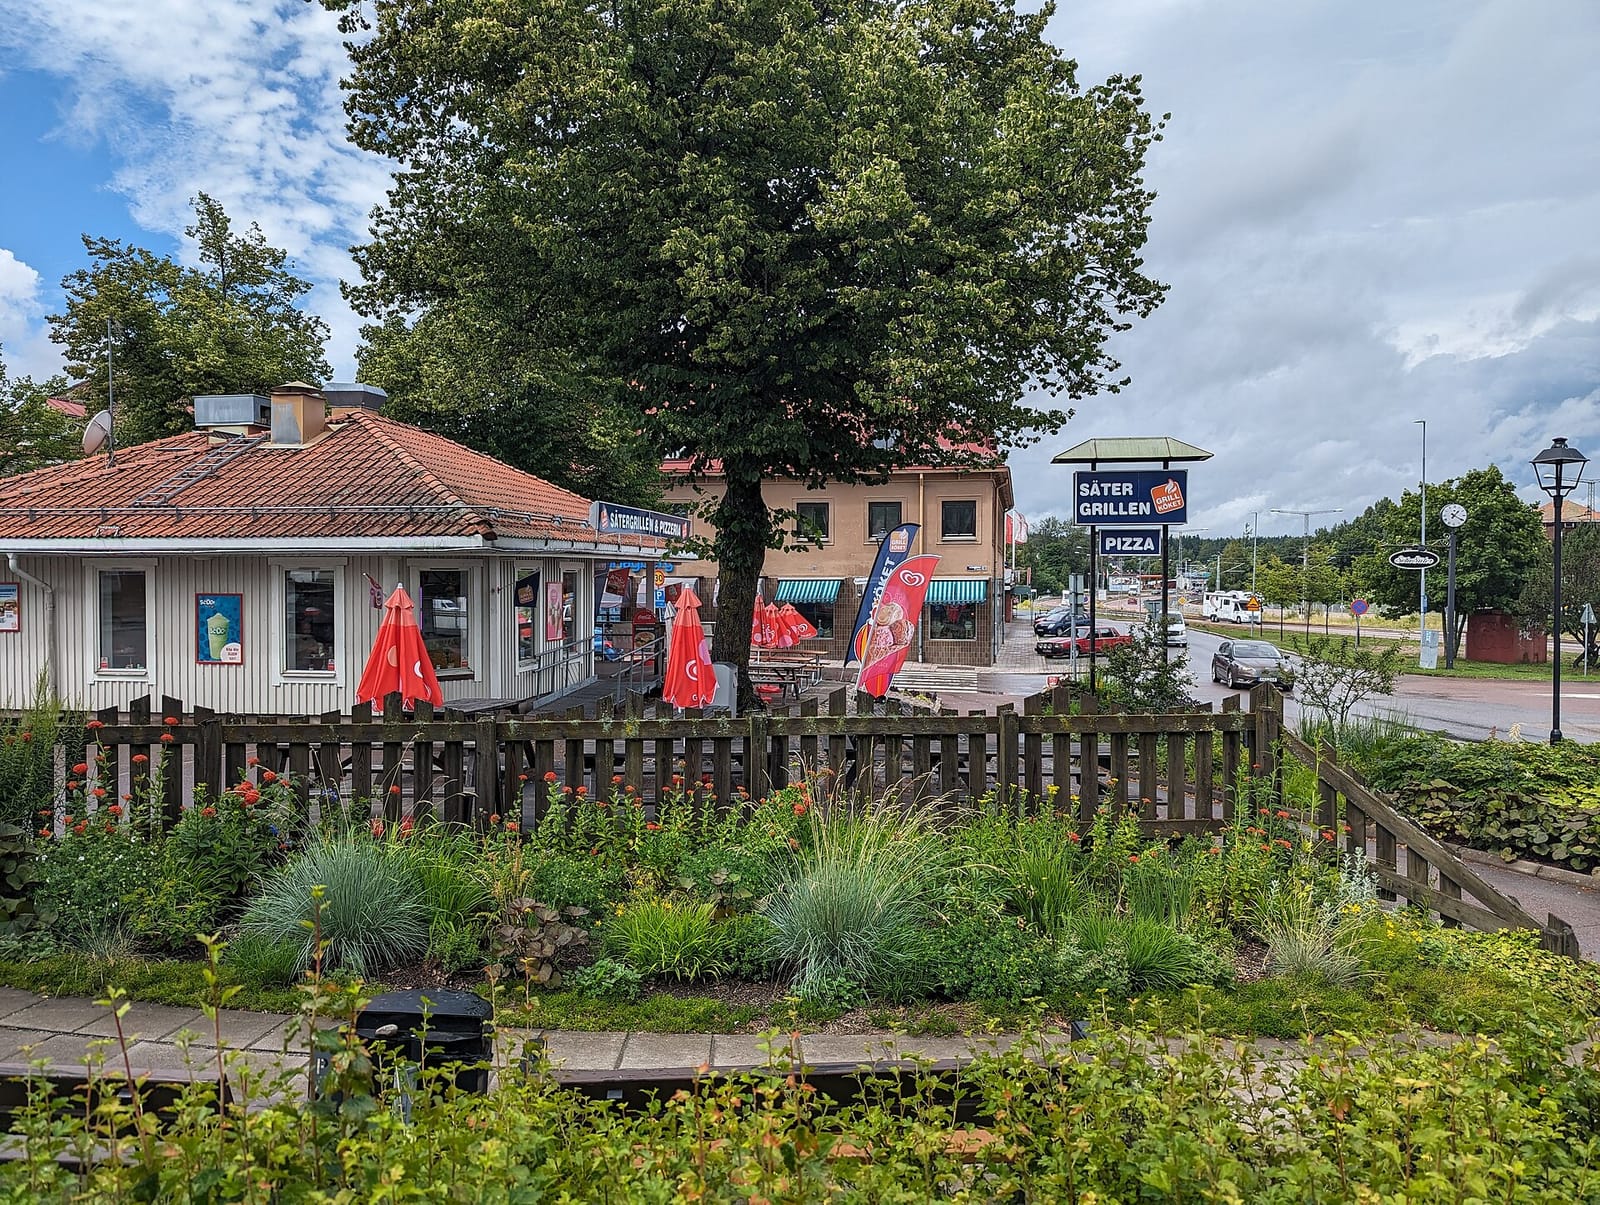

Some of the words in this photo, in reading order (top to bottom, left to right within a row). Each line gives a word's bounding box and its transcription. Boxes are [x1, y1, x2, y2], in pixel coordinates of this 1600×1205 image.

[1079, 480, 1133, 496] SÄTER
[1156, 493, 1181, 504] GRILL
[1079, 502, 1151, 516] GRILLEN
[654, 519, 659, 533] &
[659, 520, 682, 536] PIZZERIA
[1105, 537, 1155, 551] PIZZA
[654, 574, 662, 582] 30
